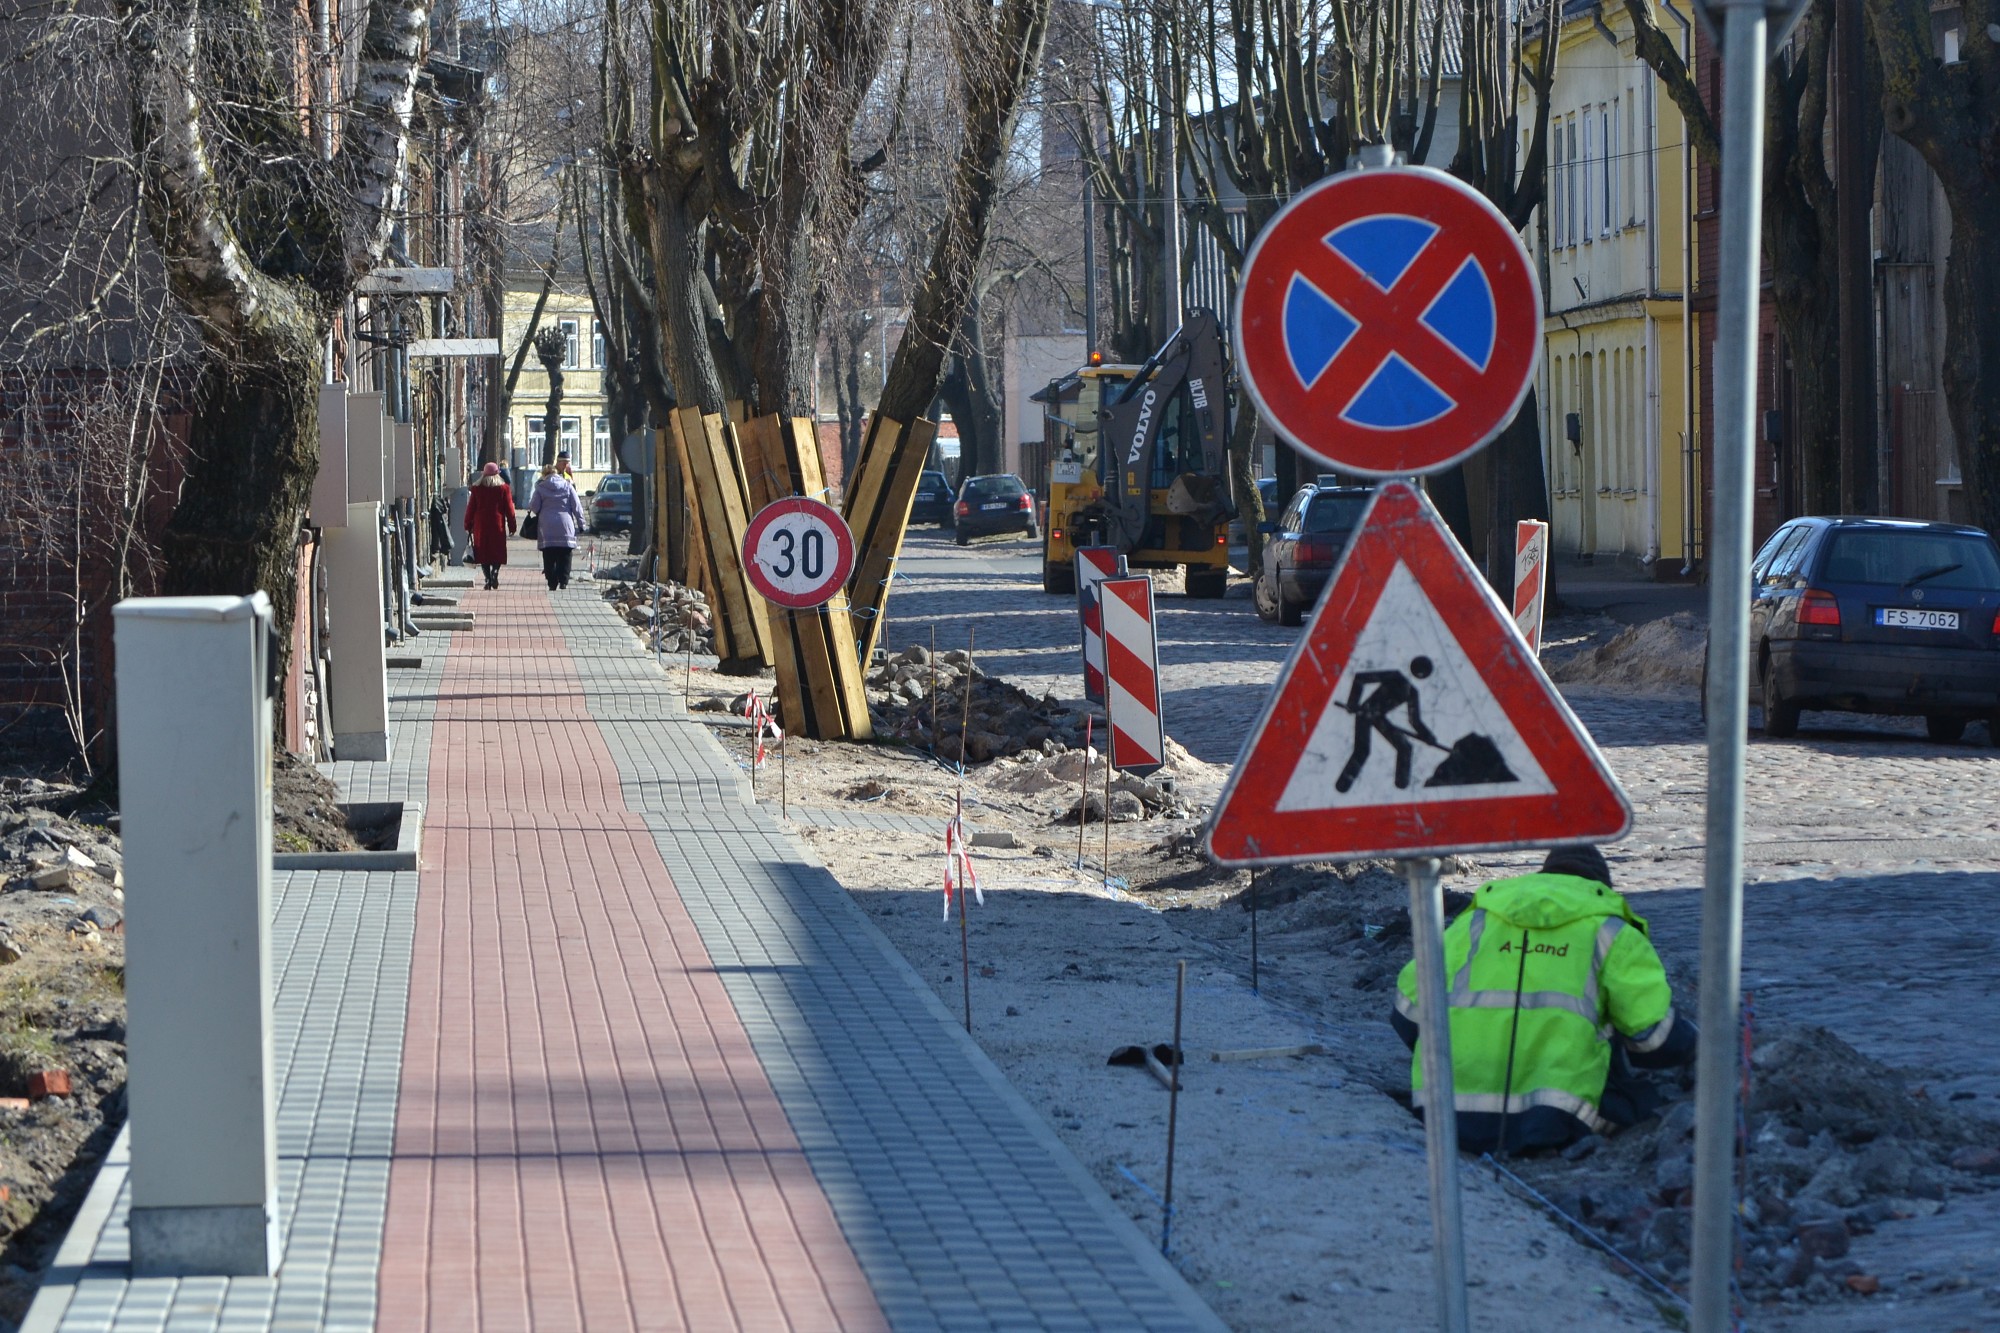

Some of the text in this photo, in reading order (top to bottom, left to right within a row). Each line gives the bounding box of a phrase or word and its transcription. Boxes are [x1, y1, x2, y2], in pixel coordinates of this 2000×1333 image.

[1189, 378, 1208, 409] BL71B
[1127, 389, 1156, 465] VOLVO
[772, 528, 824, 579] 30
[1886, 610, 1957, 628] FS-7062
